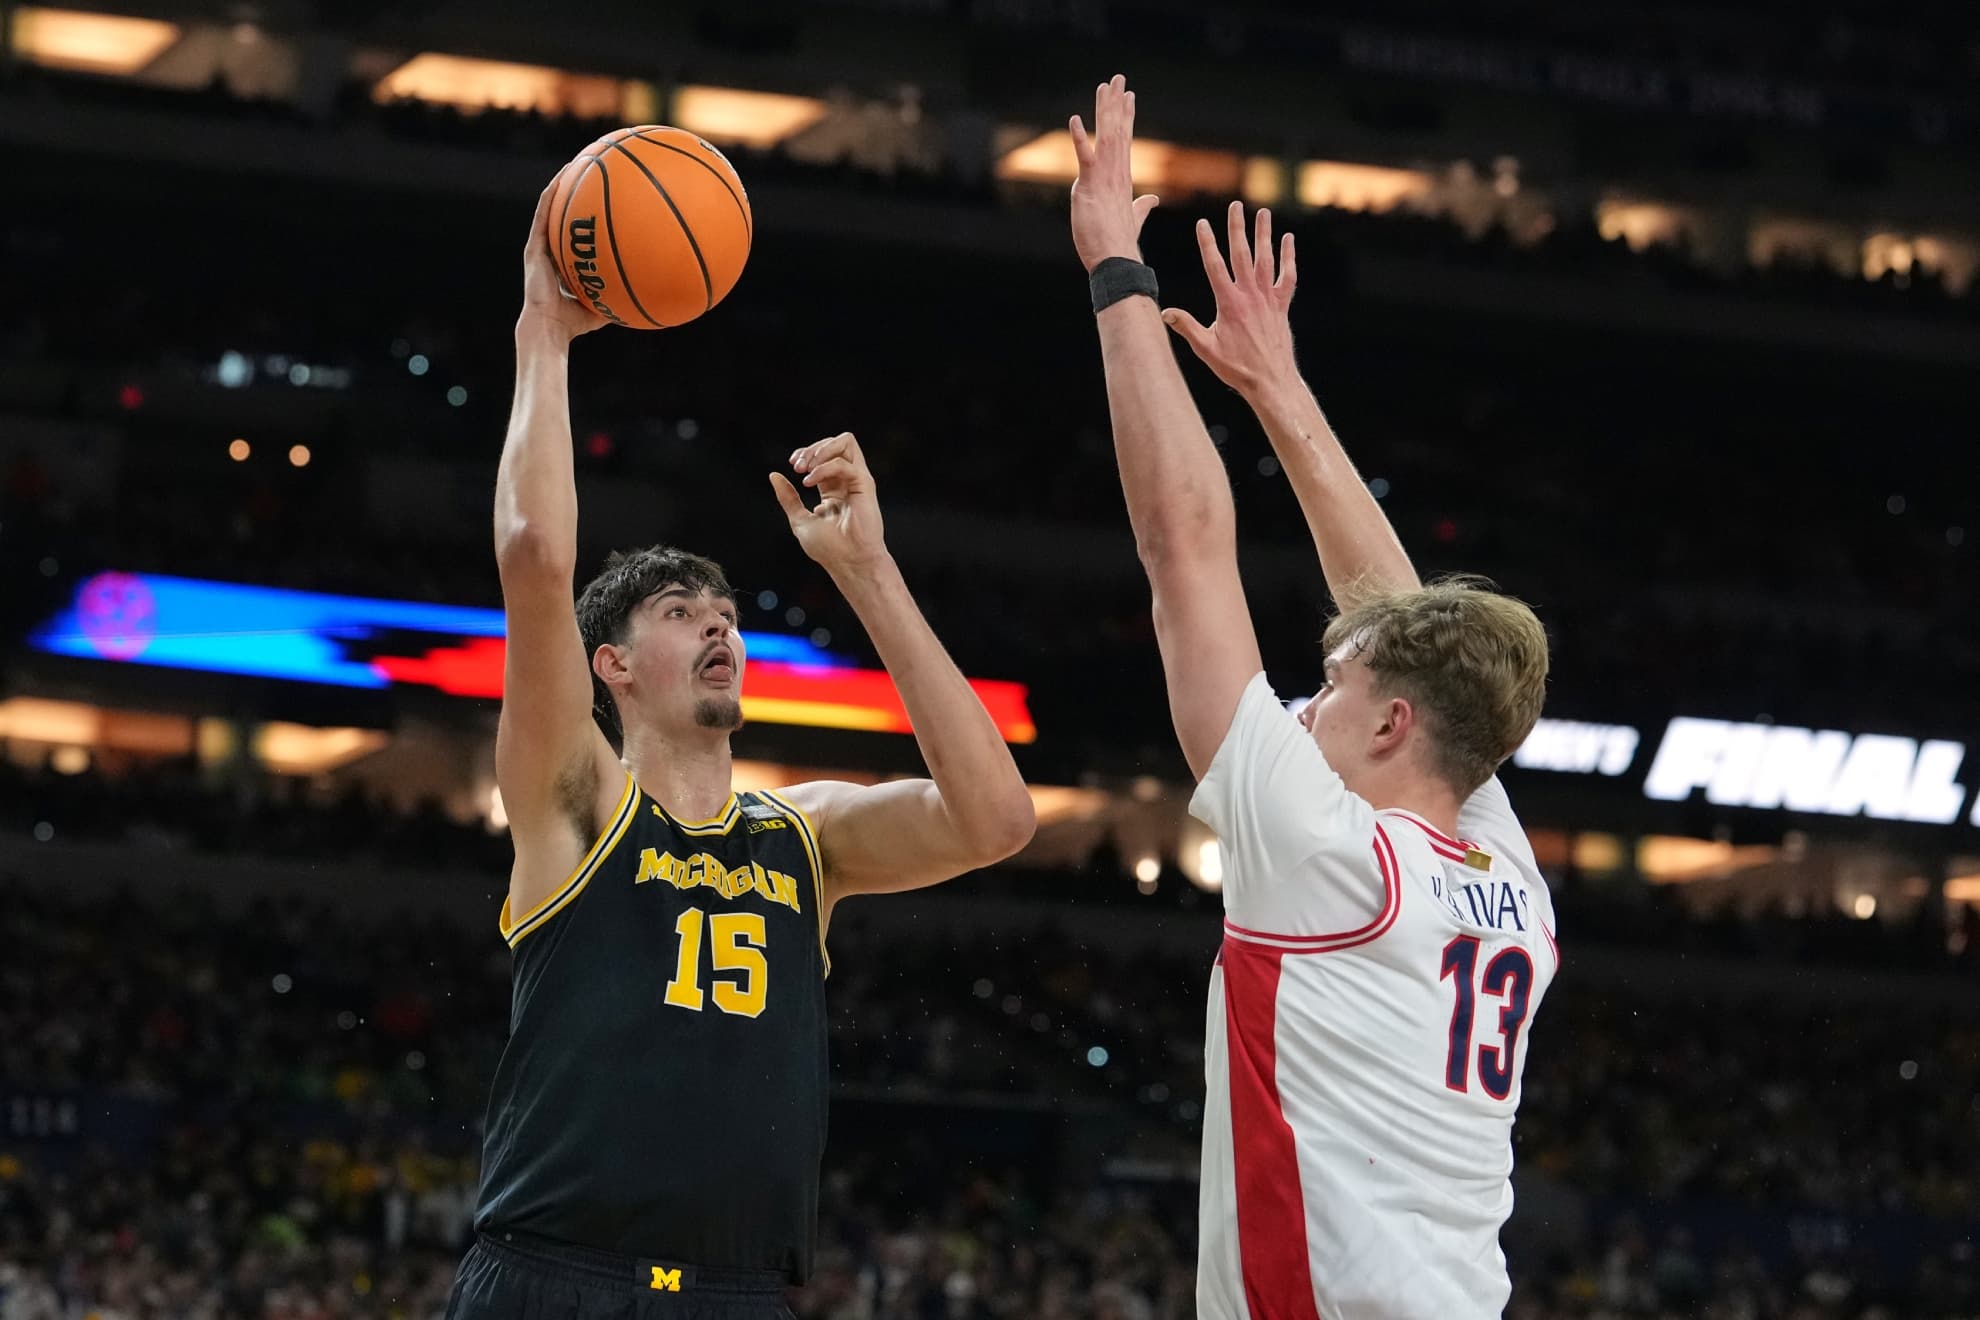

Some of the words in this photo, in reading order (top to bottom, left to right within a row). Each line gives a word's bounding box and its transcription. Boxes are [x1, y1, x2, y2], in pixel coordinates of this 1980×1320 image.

[569, 214, 627, 325] Wilso
[1643, 716, 1966, 824] FINAL
[635, 848, 801, 914] MICHIGAN
[664, 906, 768, 1019] 15
[1440, 934, 1534, 1101] 13
[650, 1266, 682, 1292] M
